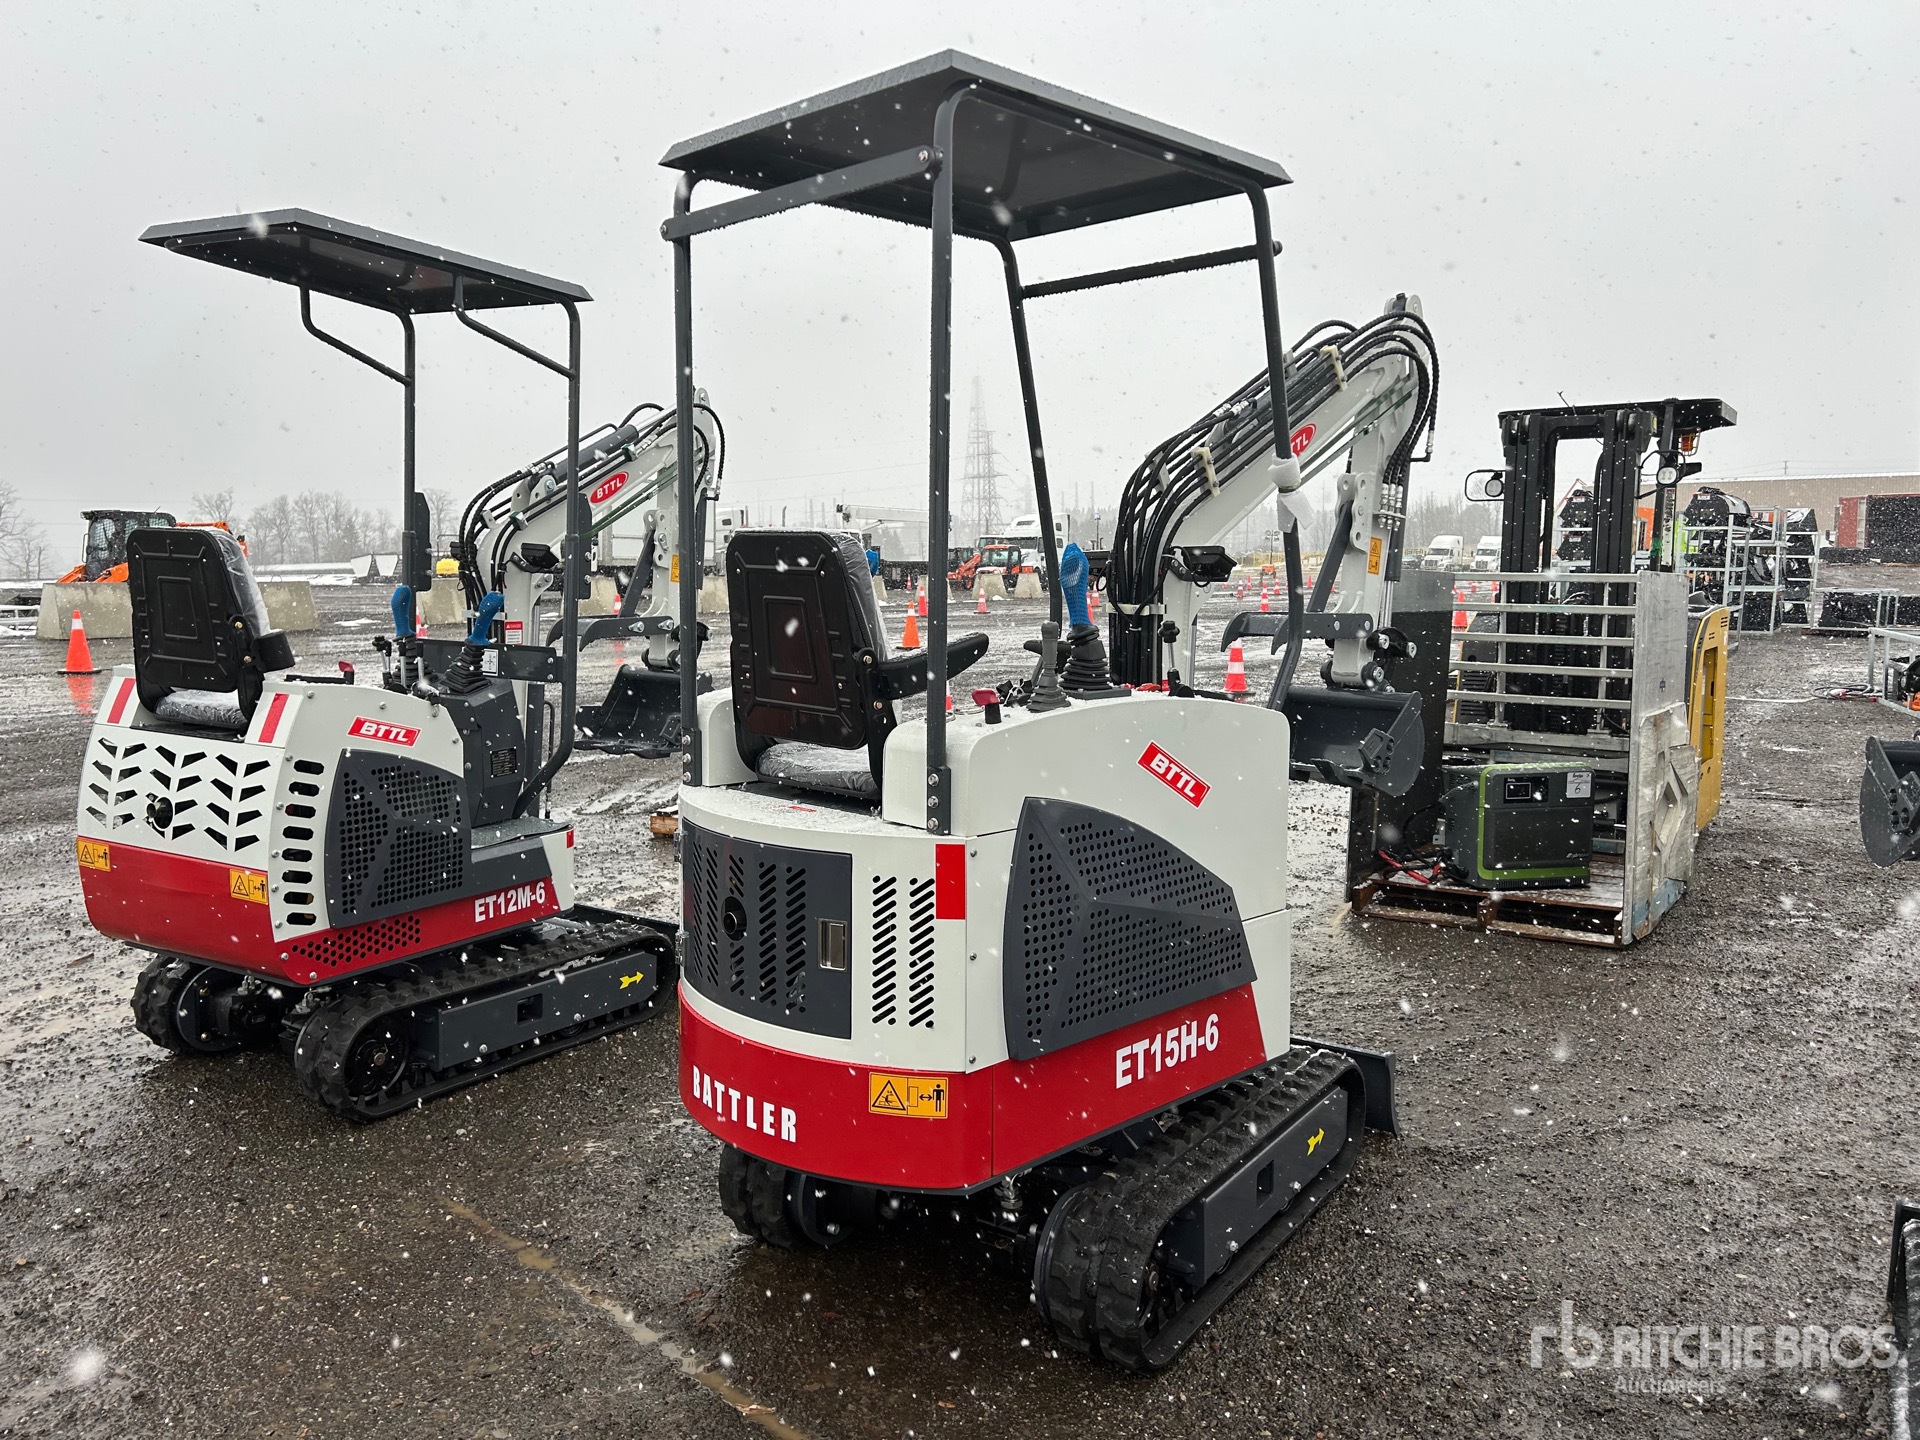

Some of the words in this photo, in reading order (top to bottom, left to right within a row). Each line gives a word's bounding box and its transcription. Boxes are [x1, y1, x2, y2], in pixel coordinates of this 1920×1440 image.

[1291, 433, 1309, 453] TTL
[597, 477, 623, 499] BTTL
[359, 722, 409, 742] BTTL
[1149, 752, 1197, 798] BTTL
[475, 881, 546, 923] ET12M-6
[1116, 1013, 1219, 1089] ET15H-6
[693, 1064, 796, 1143] BATTLER
